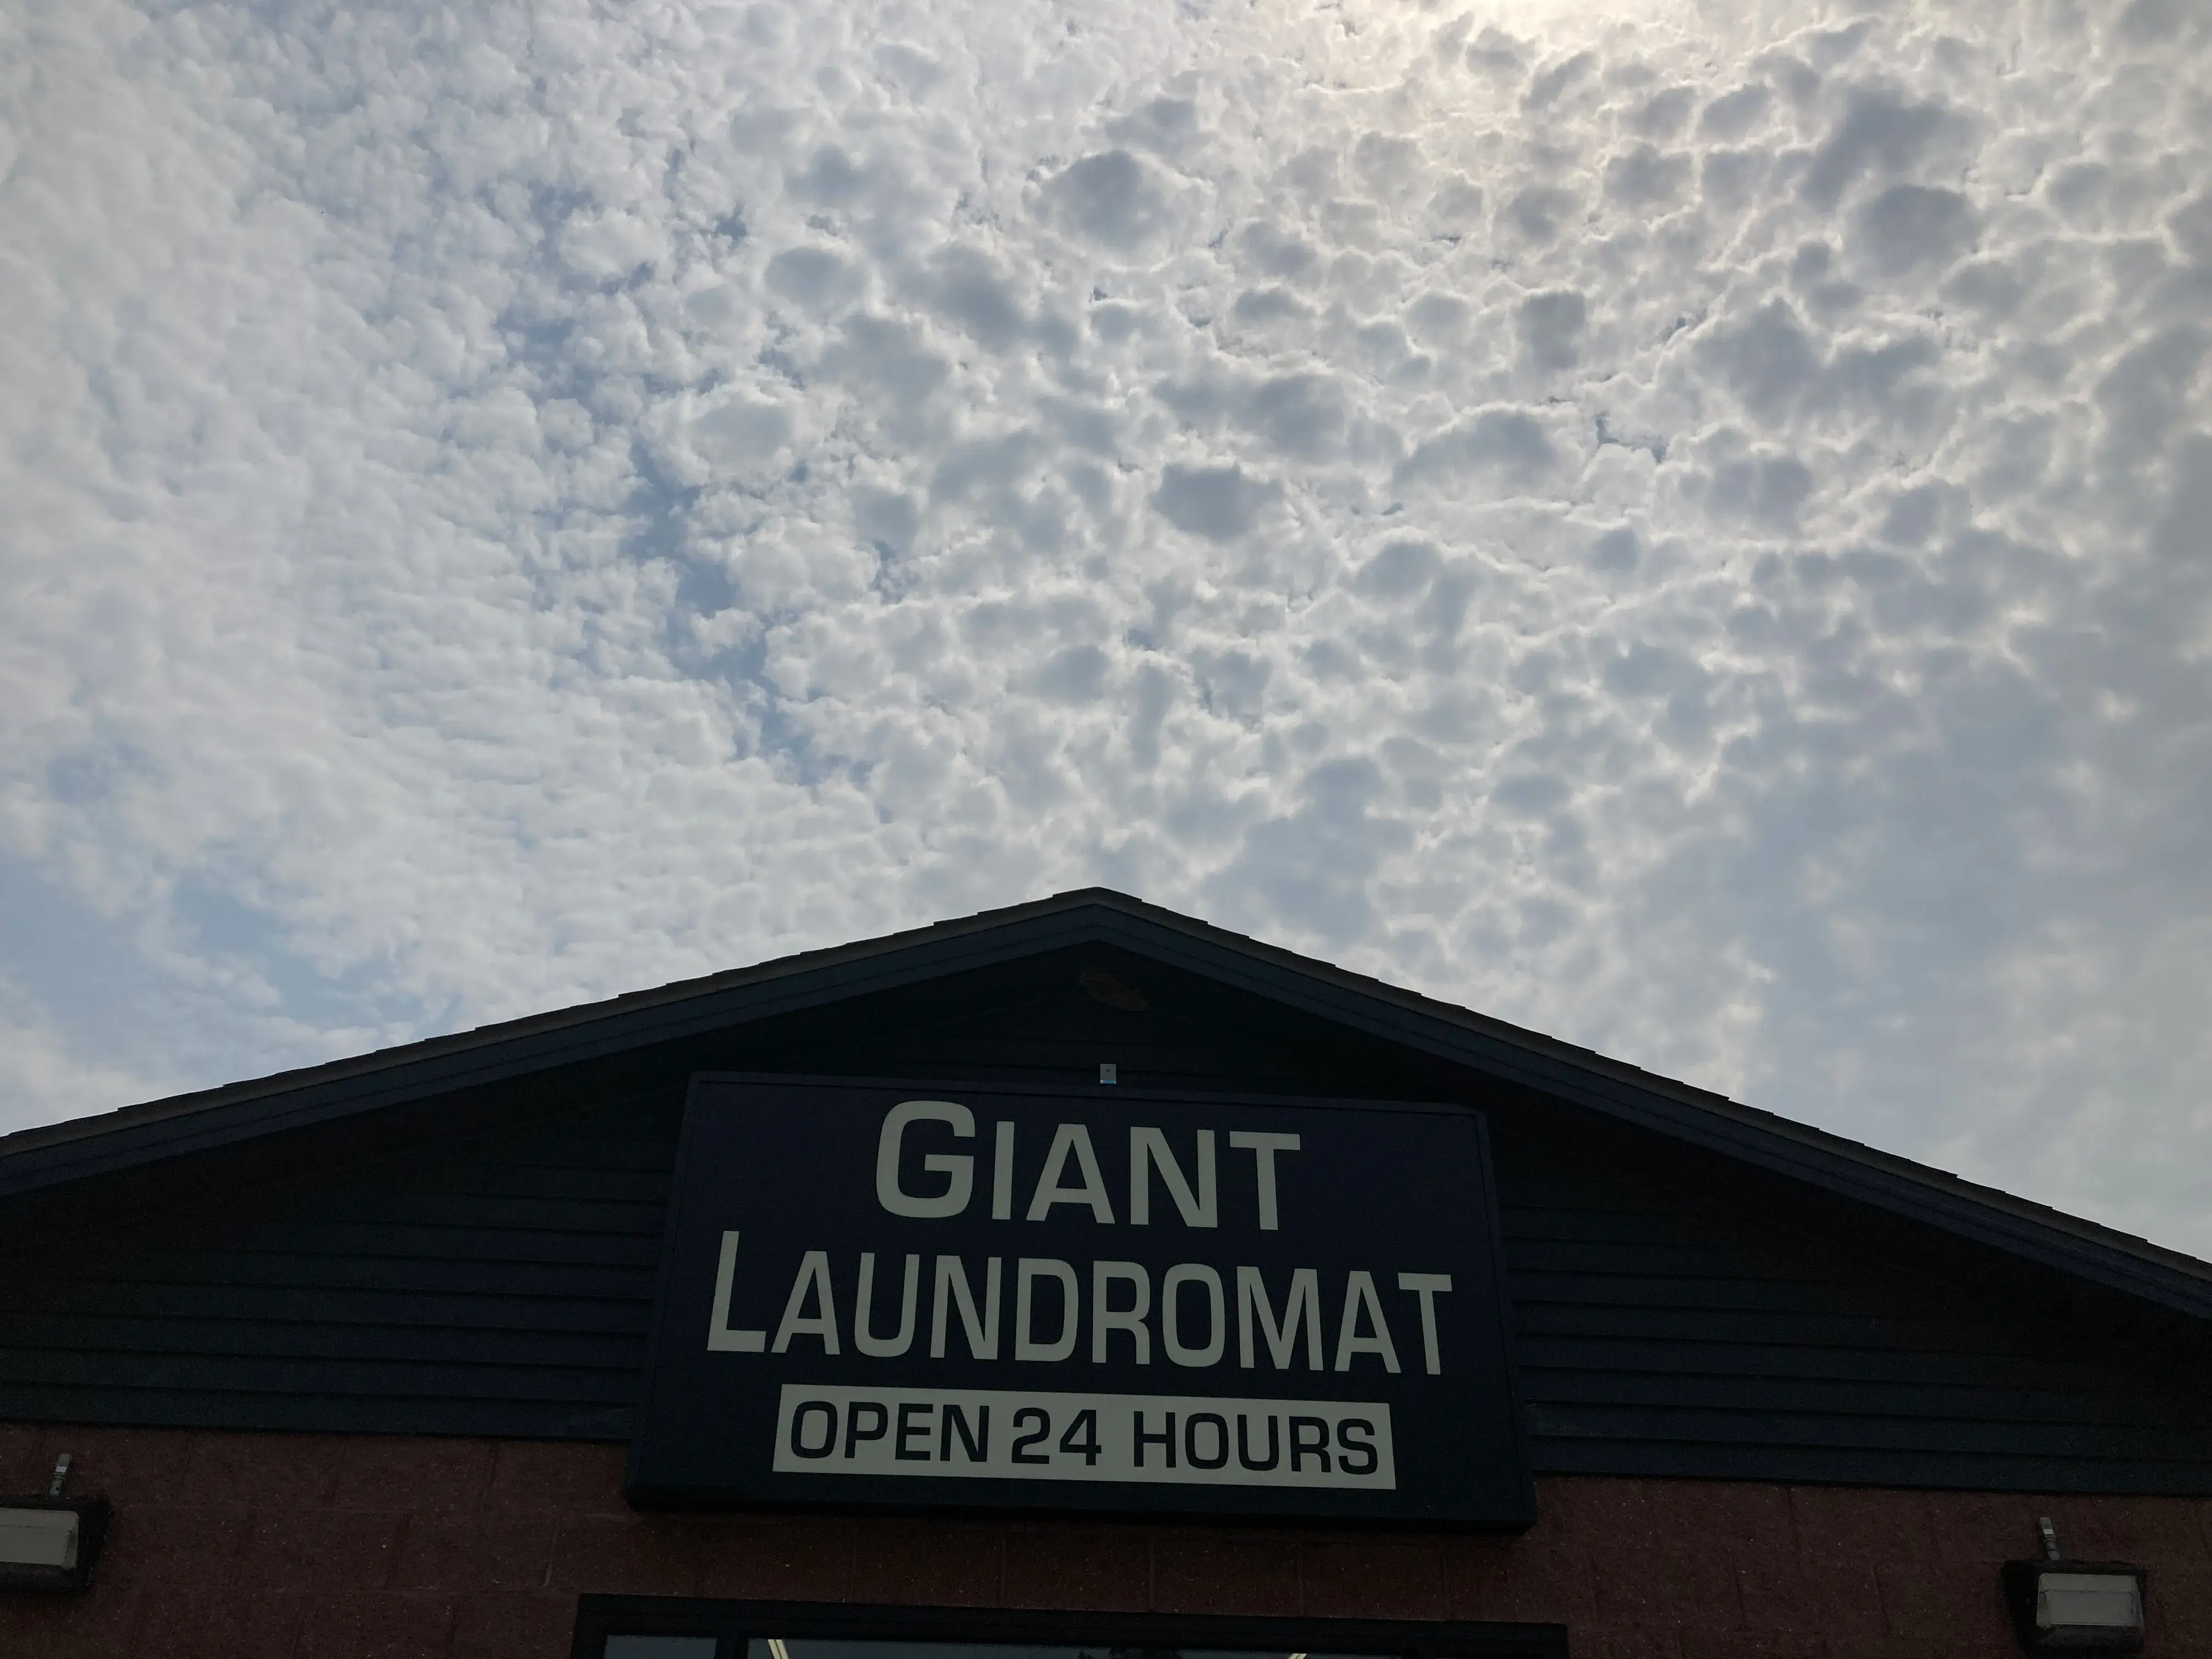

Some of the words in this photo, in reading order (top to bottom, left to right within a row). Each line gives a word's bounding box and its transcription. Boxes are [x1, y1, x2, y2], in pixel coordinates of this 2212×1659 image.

[876, 1101, 1301, 1231] GIANT
[707, 1231, 1452, 1375] LAUNDROMAT
[790, 1400, 990, 1463] OPEN
[1011, 1407, 1103, 1466] 24
[1133, 1410, 1379, 1475] HOURS
